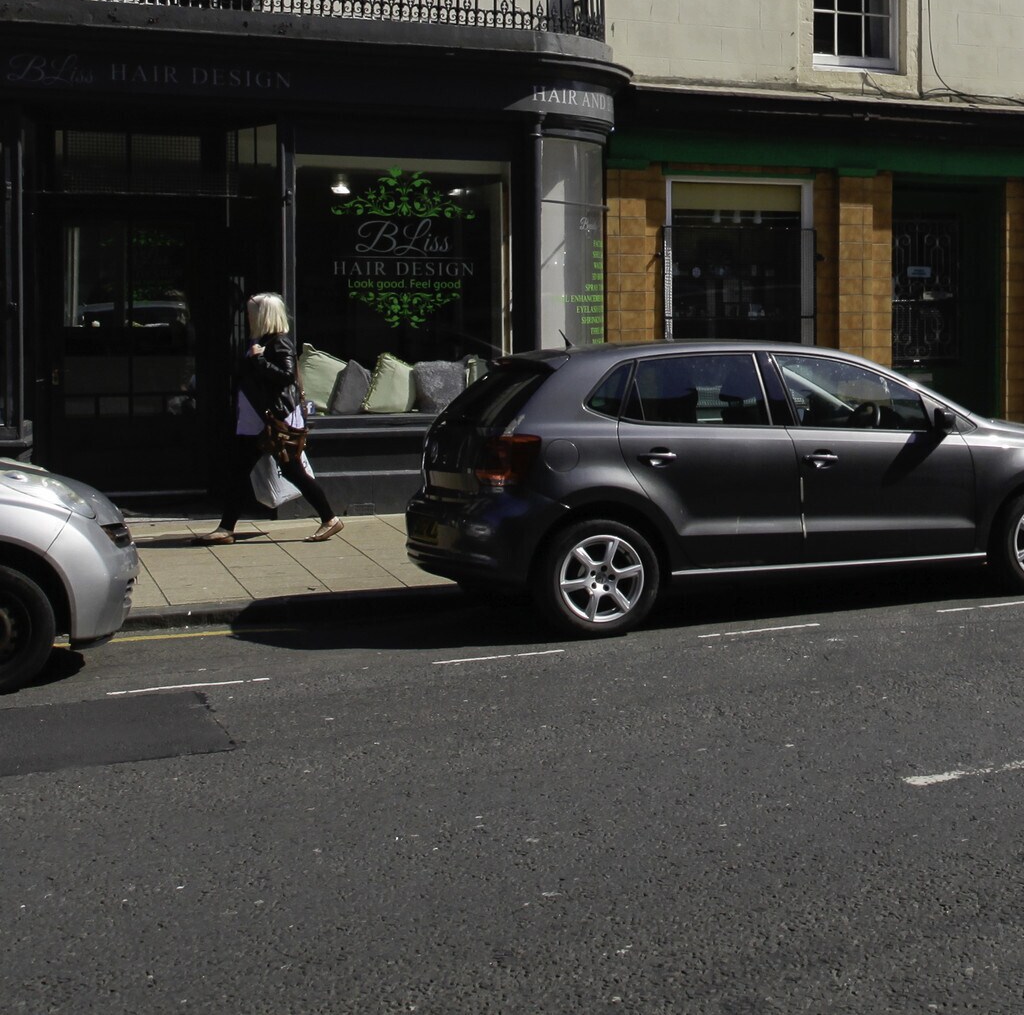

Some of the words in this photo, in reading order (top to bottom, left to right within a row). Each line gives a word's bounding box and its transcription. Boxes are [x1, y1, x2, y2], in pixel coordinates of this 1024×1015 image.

[111, 64, 178, 85] HAIR
[191, 67, 292, 90] DESIGN
[532, 85, 578, 106] HAIR
[582, 92, 606, 110] AND
[333, 261, 386, 276] HAIR
[396, 262, 475, 277] DESIGN
[347, 279, 374, 289] Look
[376, 279, 407, 292] good.
[410, 279, 431, 289] Feel
[433, 280, 462, 291] good
